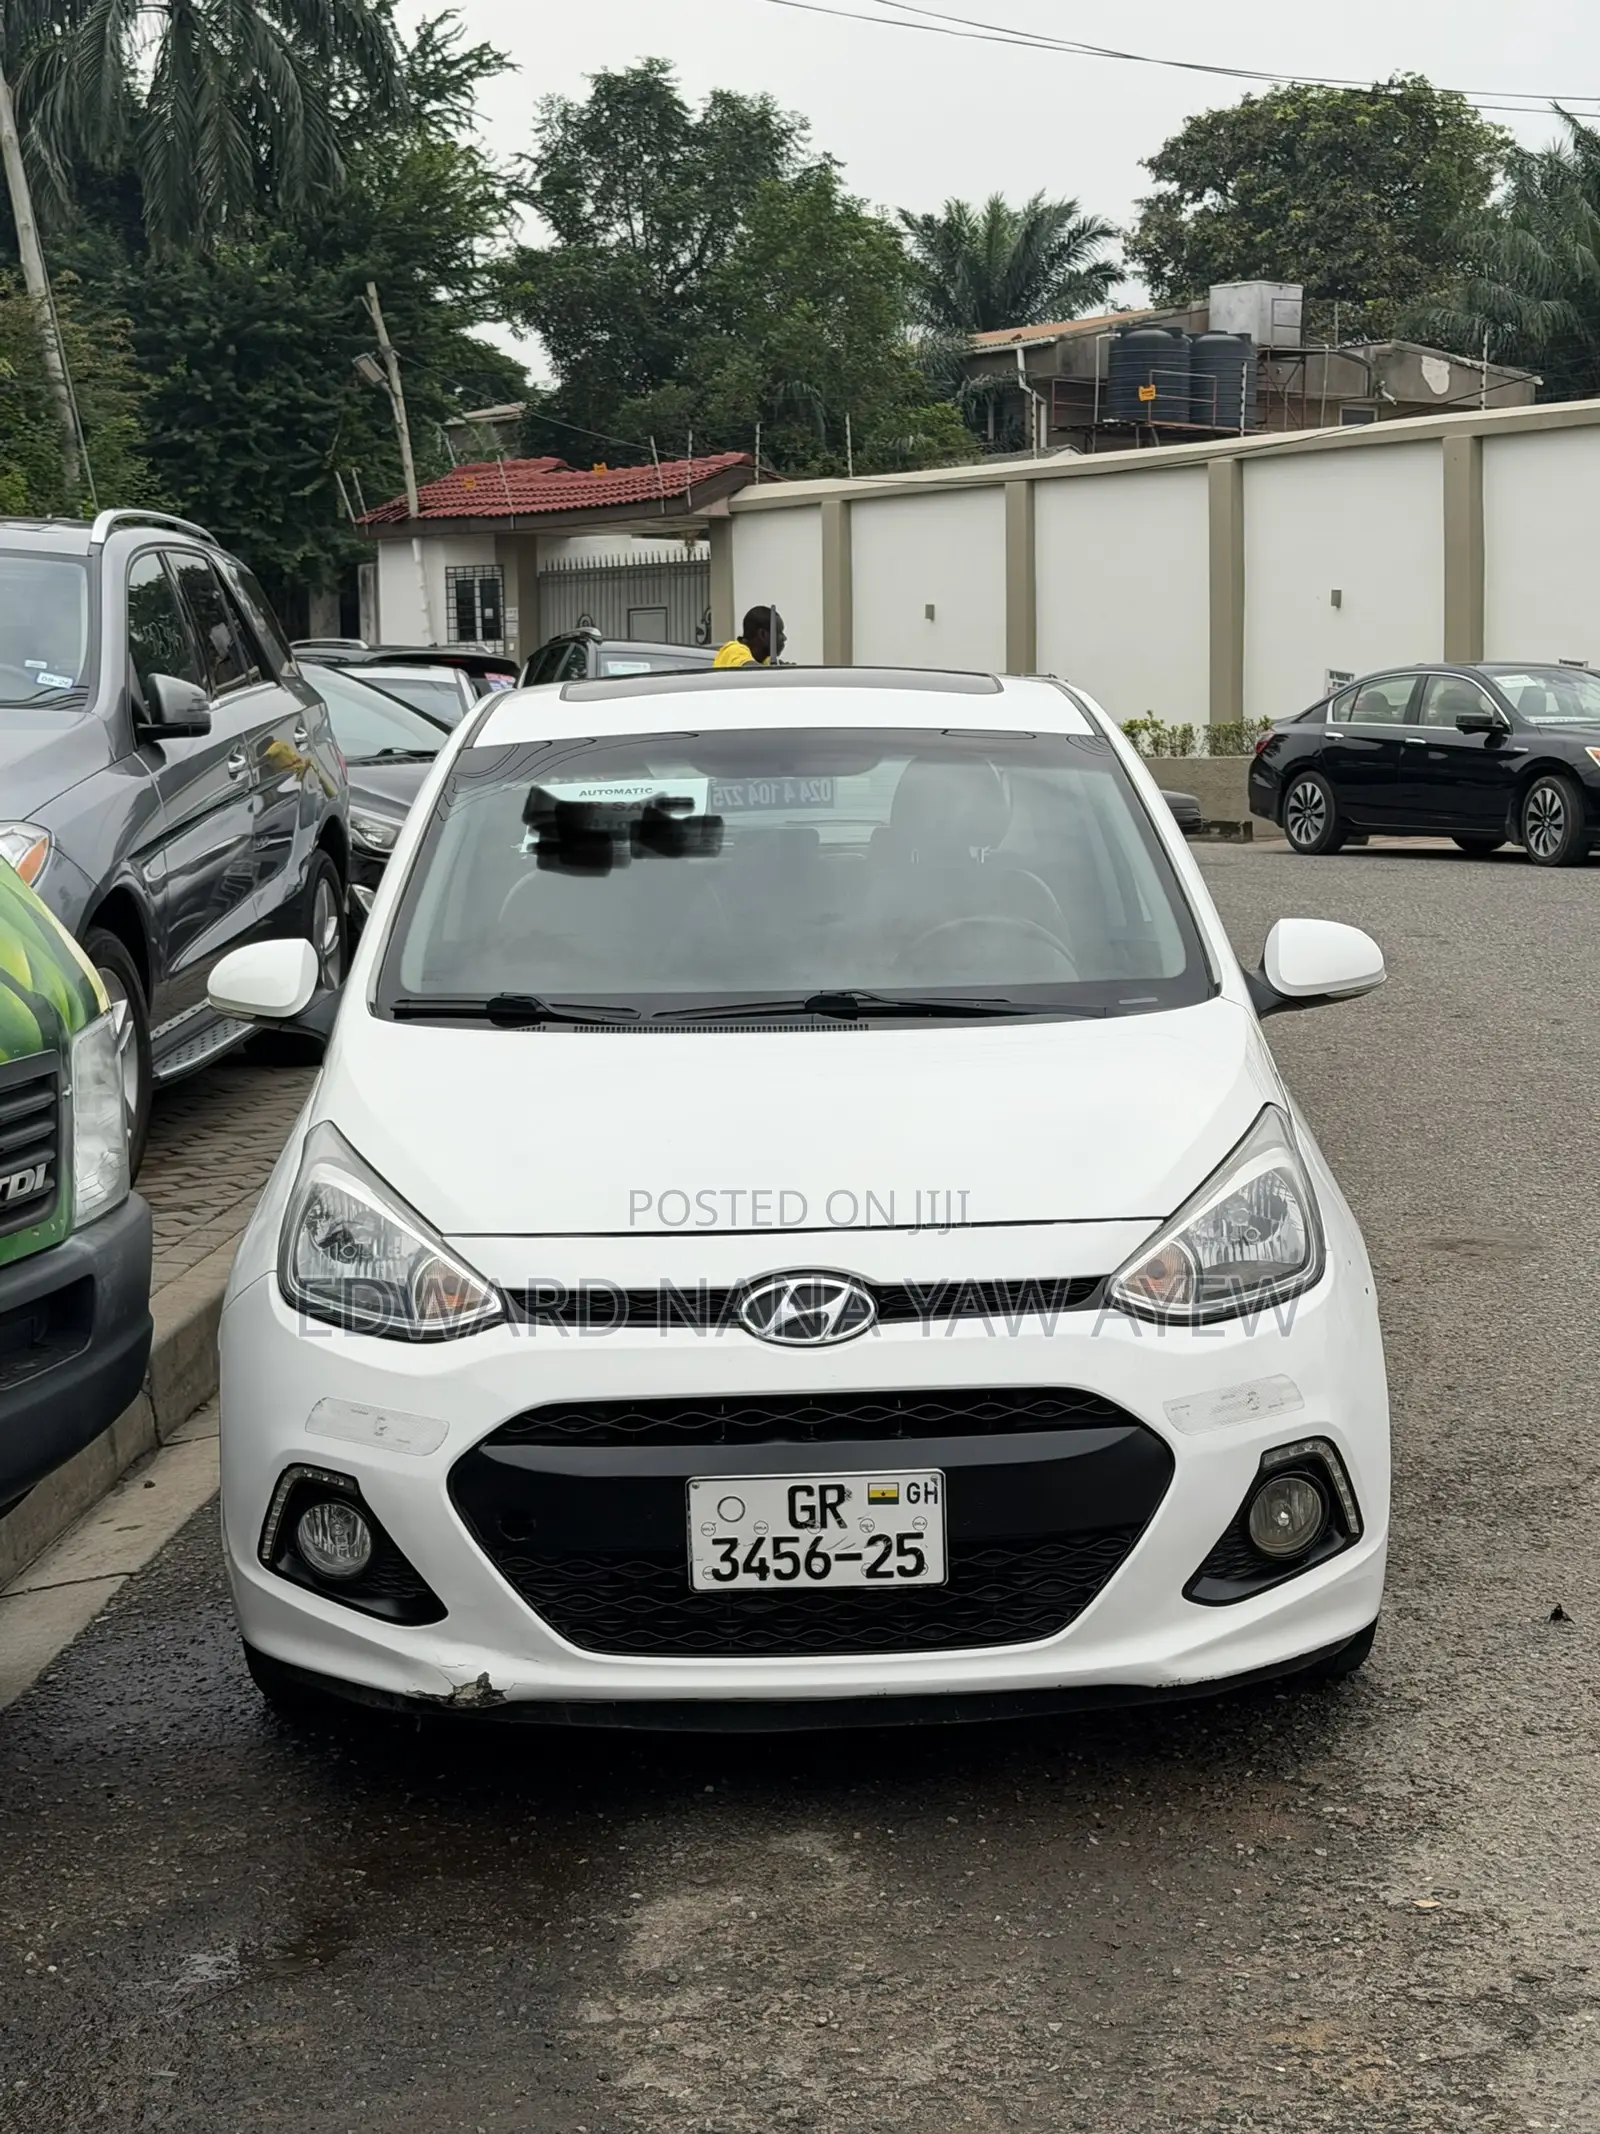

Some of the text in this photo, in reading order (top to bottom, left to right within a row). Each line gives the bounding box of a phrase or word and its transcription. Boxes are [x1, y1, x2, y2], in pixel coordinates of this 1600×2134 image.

[579, 787, 653, 797] AUTOMATIC
[787, 1484, 849, 1529] GR
[906, 1482, 938, 1504] GH
[711, 1532, 926, 1582] 3456-25
